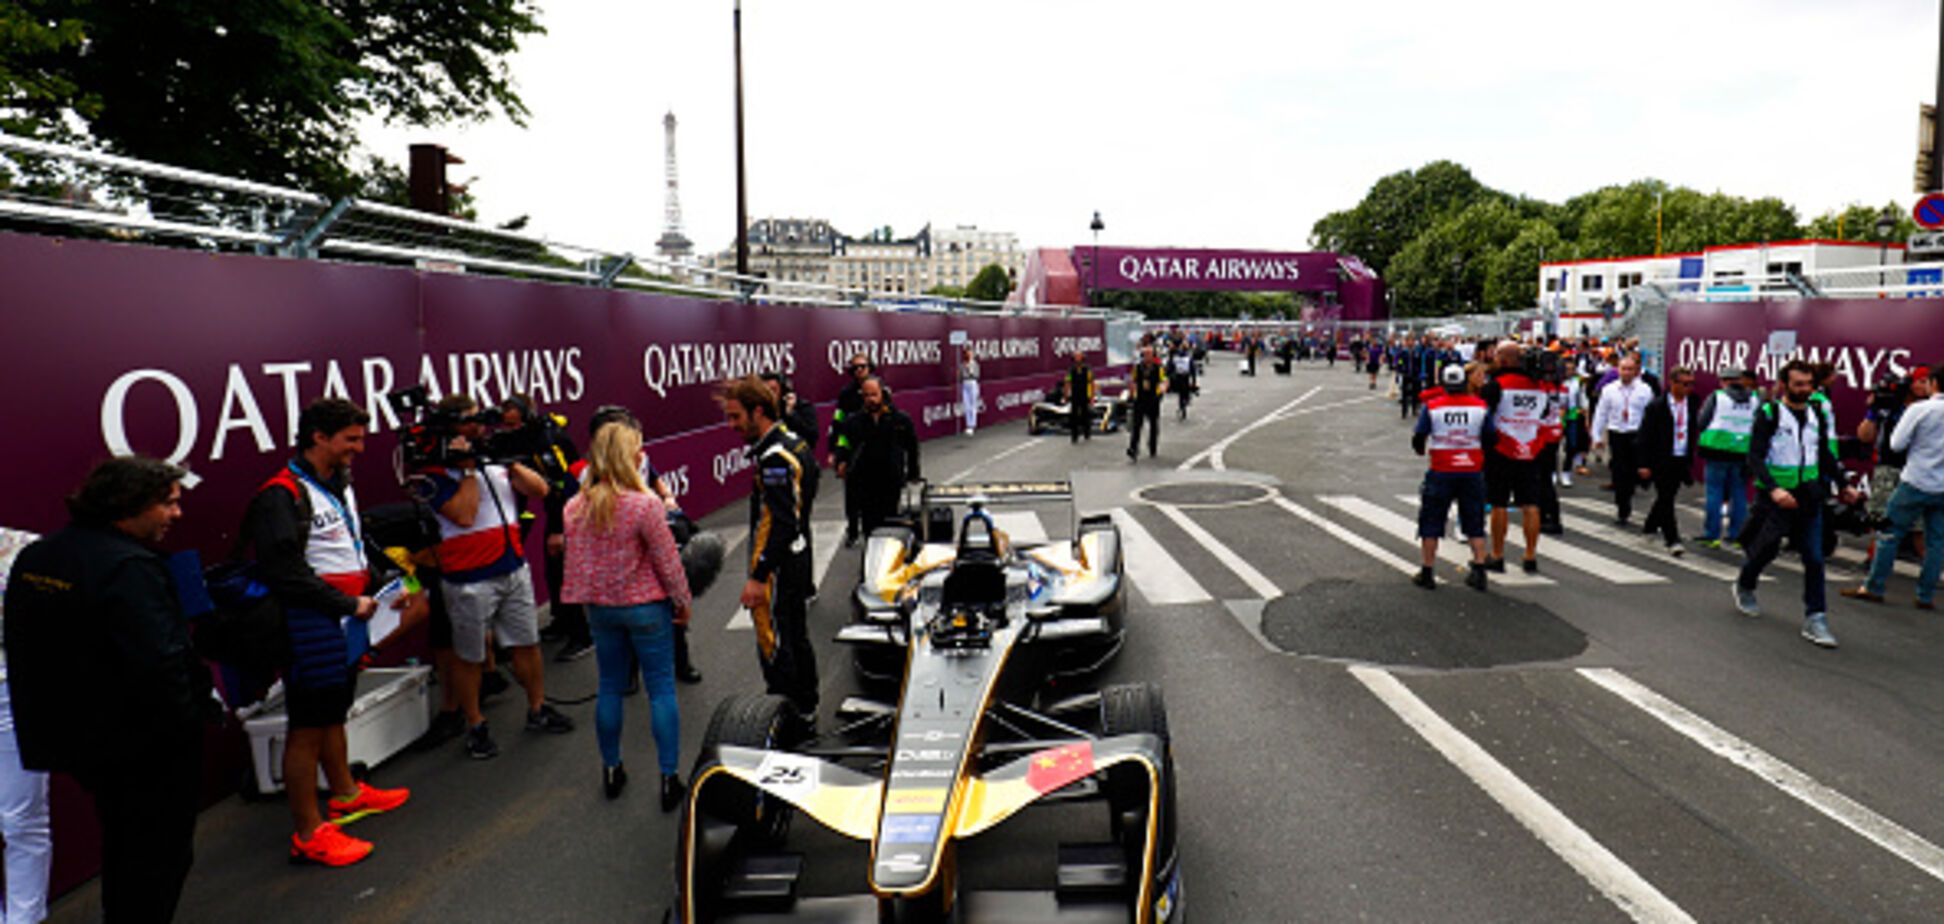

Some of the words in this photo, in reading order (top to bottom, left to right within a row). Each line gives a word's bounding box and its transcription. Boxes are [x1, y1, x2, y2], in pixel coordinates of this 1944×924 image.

[1119, 255, 1200, 283] QATAR
[1204, 257, 1300, 281] AIRWAYS
[644, 344, 716, 398] QATAR
[716, 342, 795, 382] AIRWAYS
[1679, 336, 1751, 378] QATAR
[760, 765, 807, 784] 25
